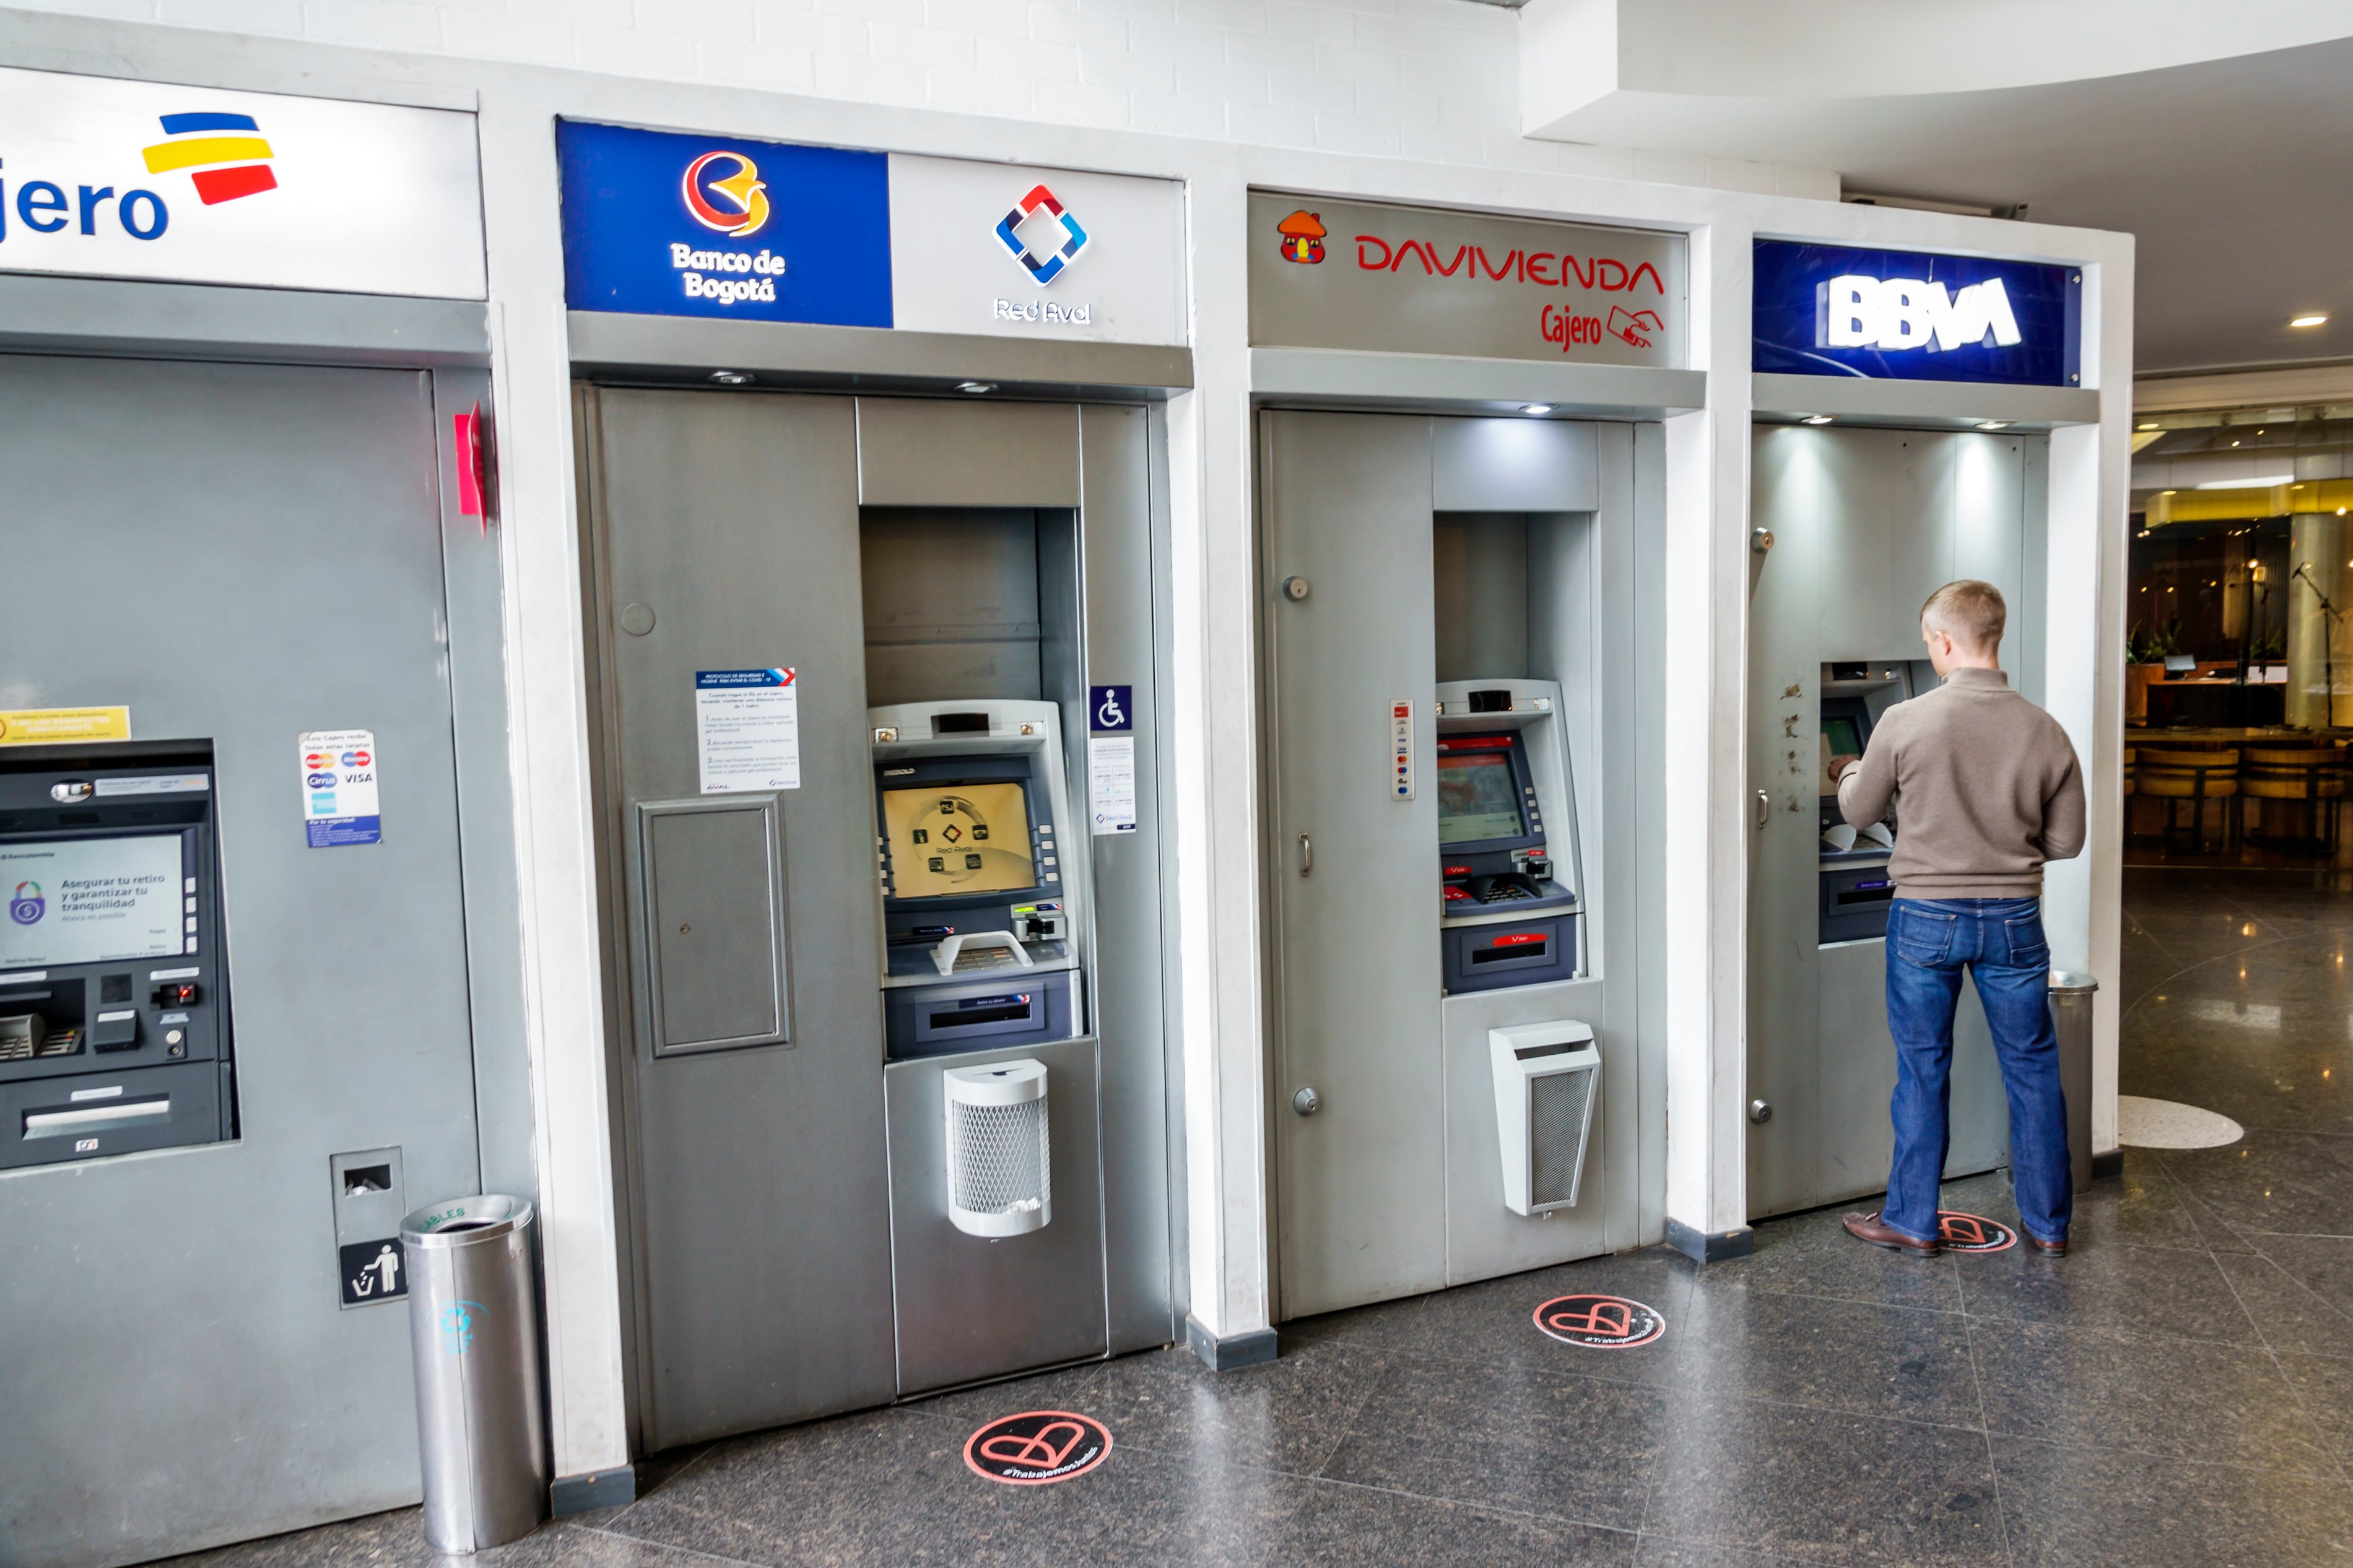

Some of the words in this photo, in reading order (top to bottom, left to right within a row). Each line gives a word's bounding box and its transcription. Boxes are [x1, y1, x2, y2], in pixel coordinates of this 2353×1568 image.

[671, 243, 752, 272] Banco
[753, 249, 786, 275] de
[1355, 235, 1664, 295] DAVIVIENDA
[683, 272, 776, 305] Bogotá
[994, 298, 1040, 322] Red
[1043, 302, 1092, 325] Aval
[1824, 274, 2022, 352] BBVA
[1541, 304, 1603, 353] Cajero
[310, 776, 336, 786] Cirrus
[345, 773, 373, 783] VISA
[61, 877, 115, 890] Asegurar
[118, 876, 130, 885] tu
[133, 873, 165, 885] retiro
[61, 893, 68, 903] y
[71, 888, 132, 902] garantizar
[135, 887, 147, 895] tu
[62, 899, 136, 912] tranquilidad
[62, 913, 85, 922] Ahora
[98, 912, 127, 921] posible
